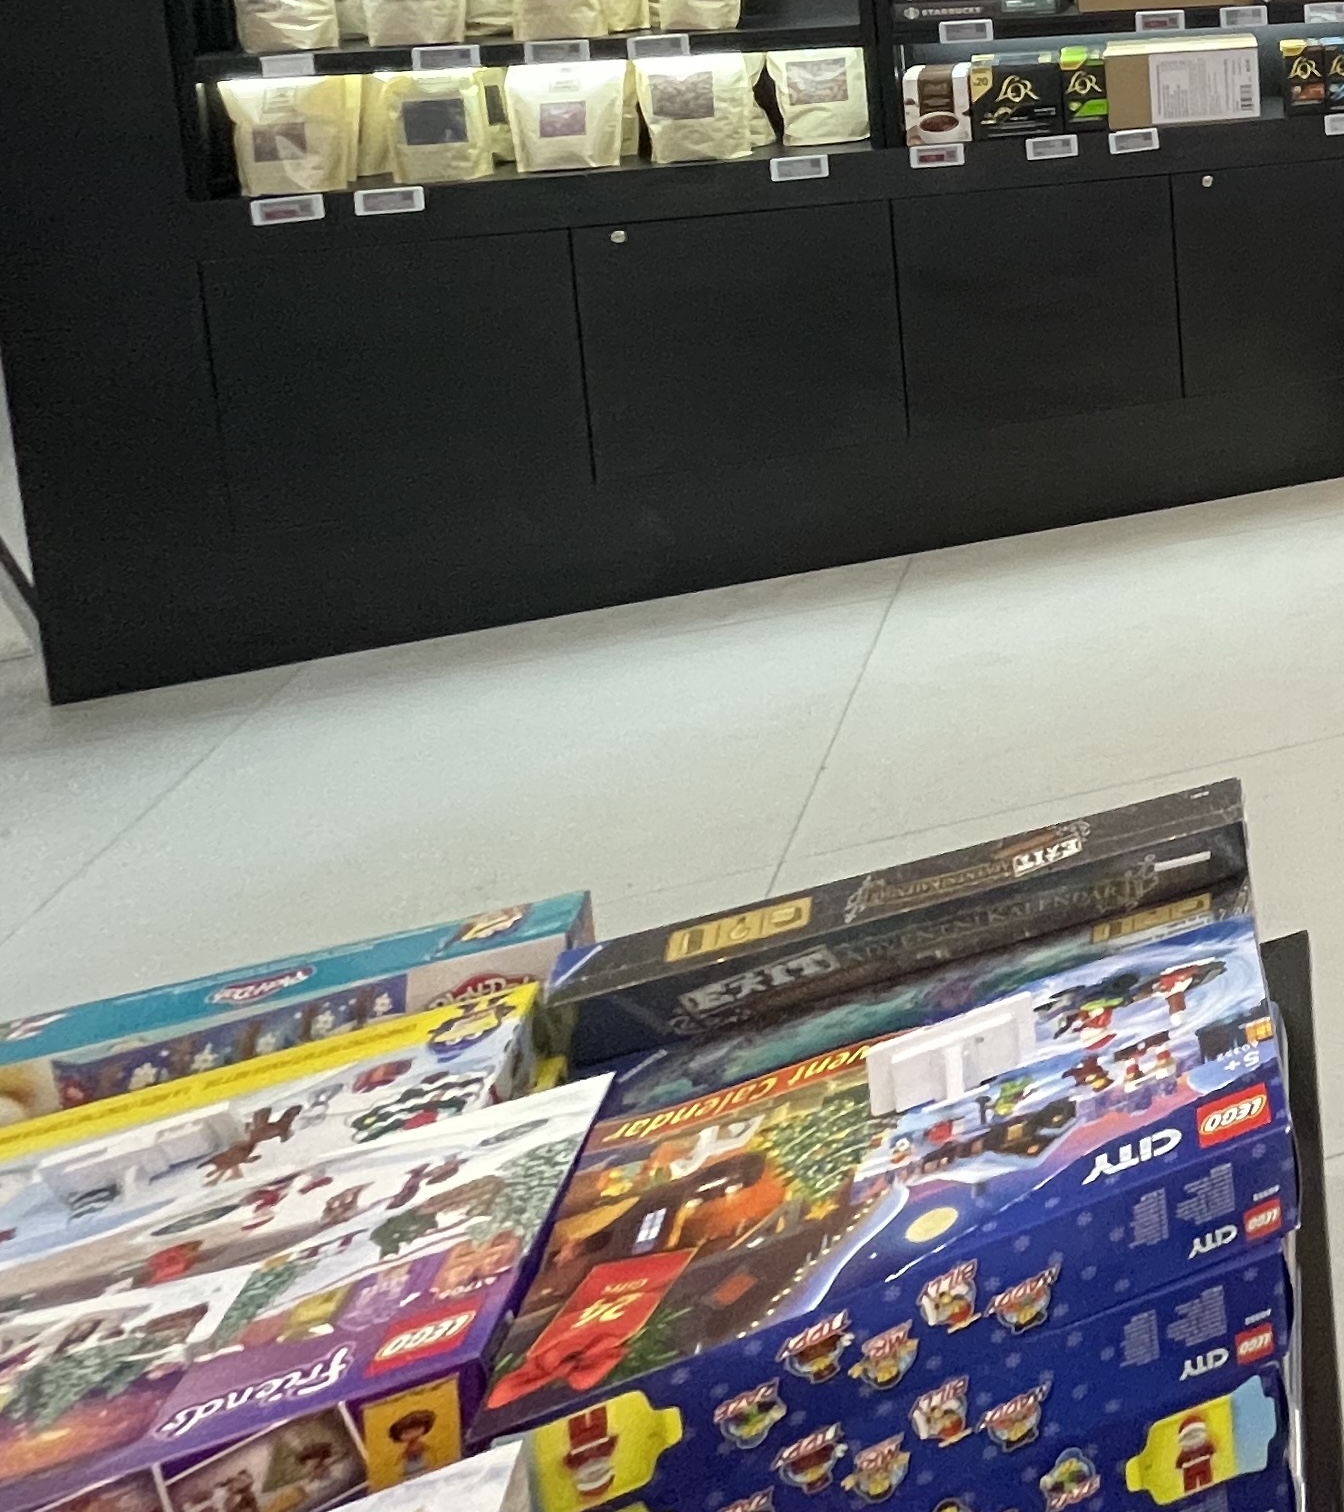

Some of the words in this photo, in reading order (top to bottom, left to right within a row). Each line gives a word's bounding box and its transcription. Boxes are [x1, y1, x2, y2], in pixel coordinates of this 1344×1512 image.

[921, 6, 983, 17] STARBUCKS
[1014, 837, 1080, 876] EXIT
[687, 949, 836, 1012] EXIT
[787, 1045, 871, 1086] vent
[1223, 1050, 1260, 1071] 5+
[602, 1076, 778, 1144] Calendar
[1203, 1096, 1264, 1133] LEGO
[1082, 1128, 1182, 1185] CITY
[1246, 1209, 1280, 1231] LEGO
[1188, 1224, 1238, 1260] CITY
[571, 1291, 644, 1329] 24
[377, 1311, 474, 1359] LEGO
[1238, 1332, 1272, 1354] LEGO
[1179, 1348, 1230, 1382] CITY
[158, 1345, 352, 1439] Friends
